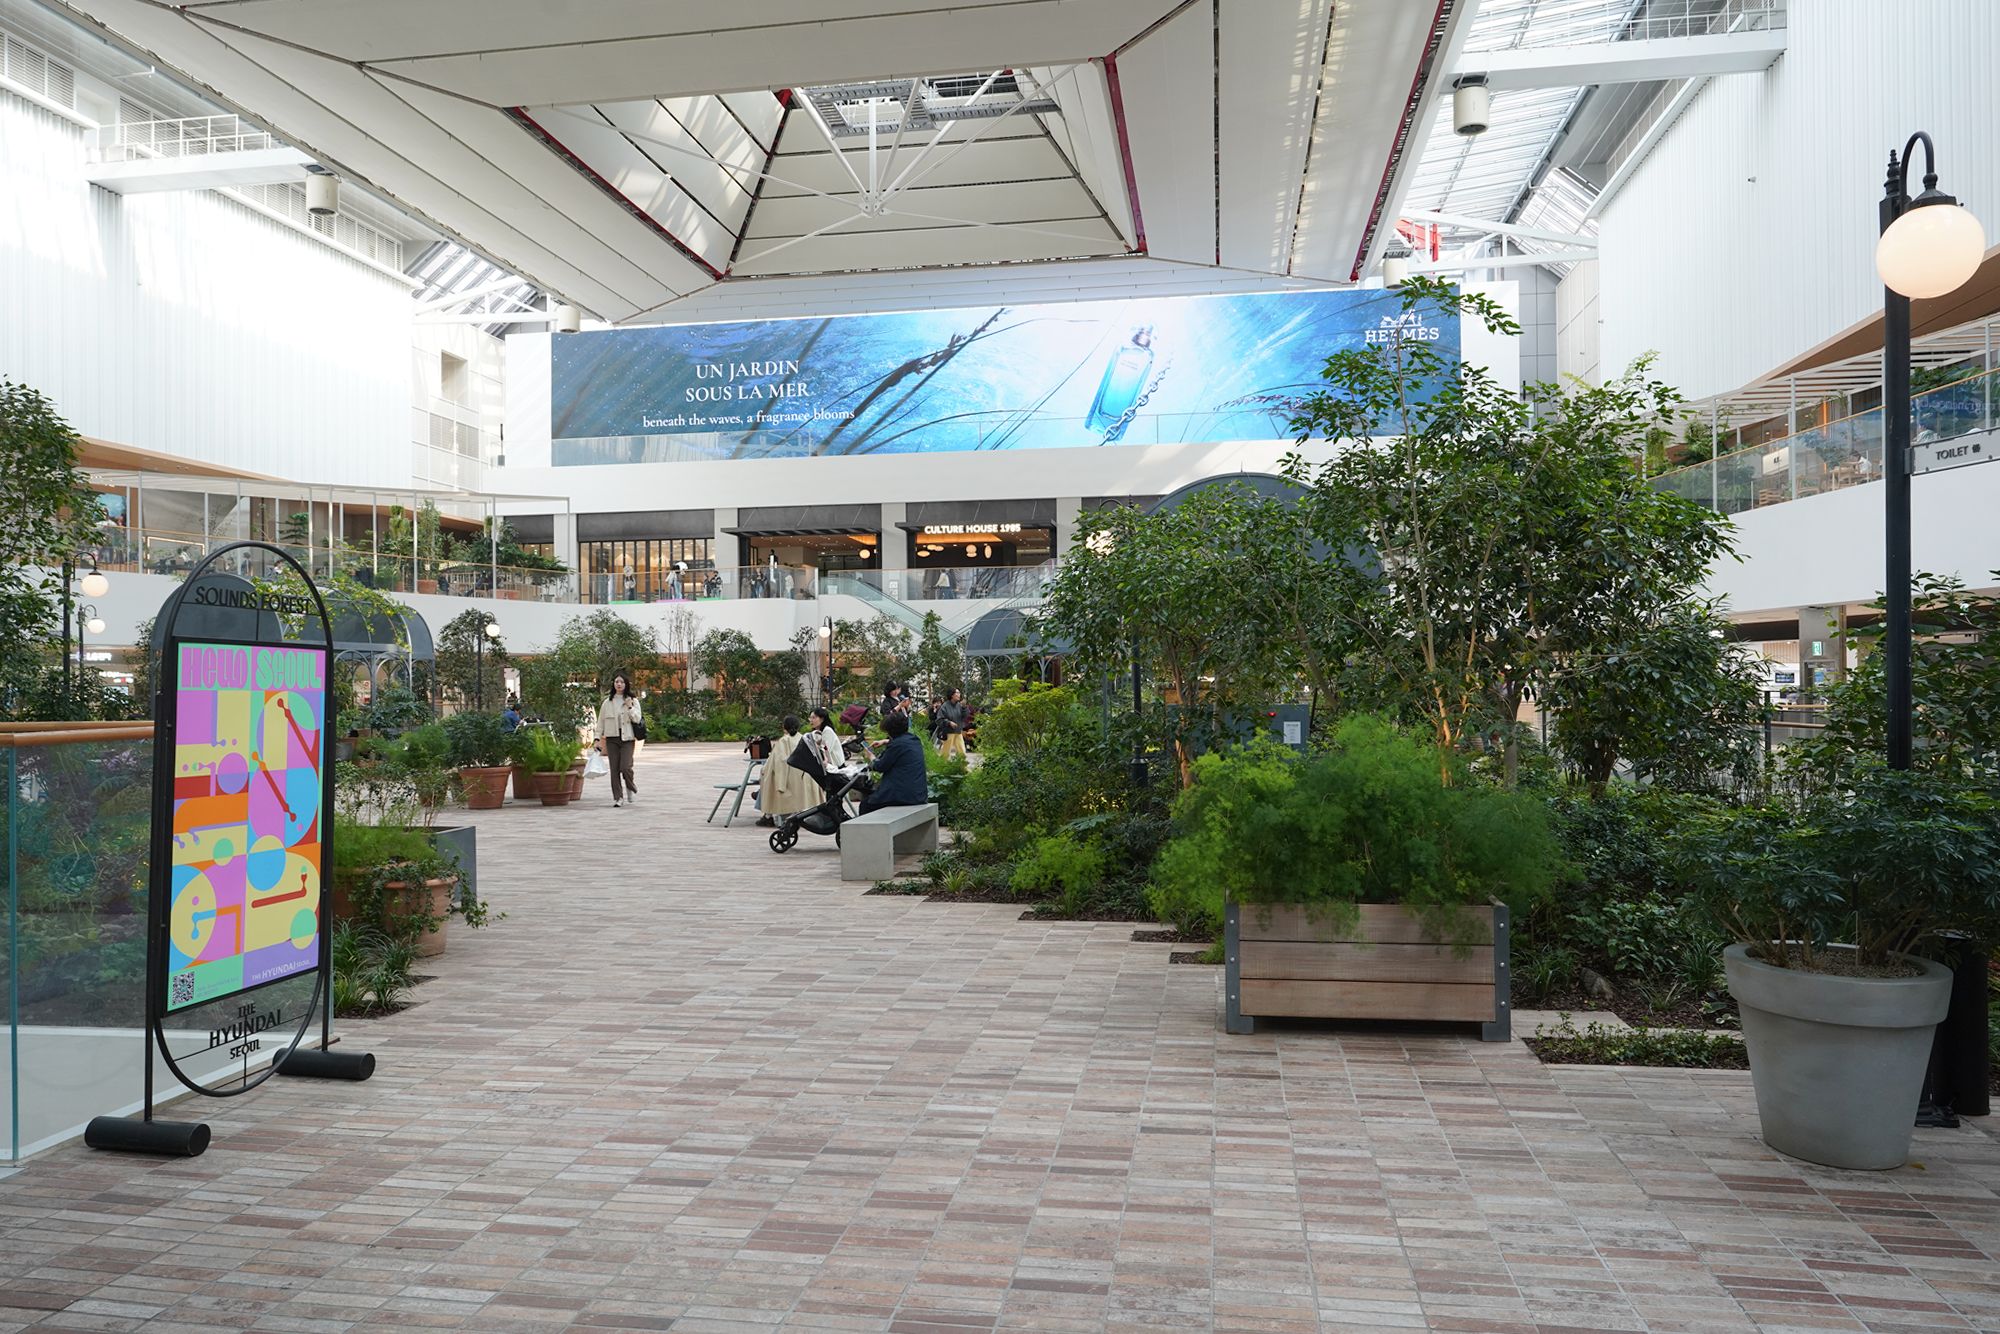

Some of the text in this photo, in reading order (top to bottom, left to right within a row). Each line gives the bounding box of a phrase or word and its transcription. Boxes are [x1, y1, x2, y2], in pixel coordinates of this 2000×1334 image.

[696, 360, 800, 382] UN JARDIN
[686, 382, 809, 403] SOUS LA MER
[643, 407, 855, 428] beneath the waves, a fragrance blooms
[1936, 446, 1969, 461] TOILET
[924, 523, 1021, 535] CULTURE HOUSE 1985
[195, 586, 312, 615] SOUNDS FOREST
[261, 961, 296, 979] HYUNDAI
[237, 1002, 256, 1019] THE
[209, 1009, 281, 1049] HYUNDAI
[230, 1039, 261, 1060] SEOUL
